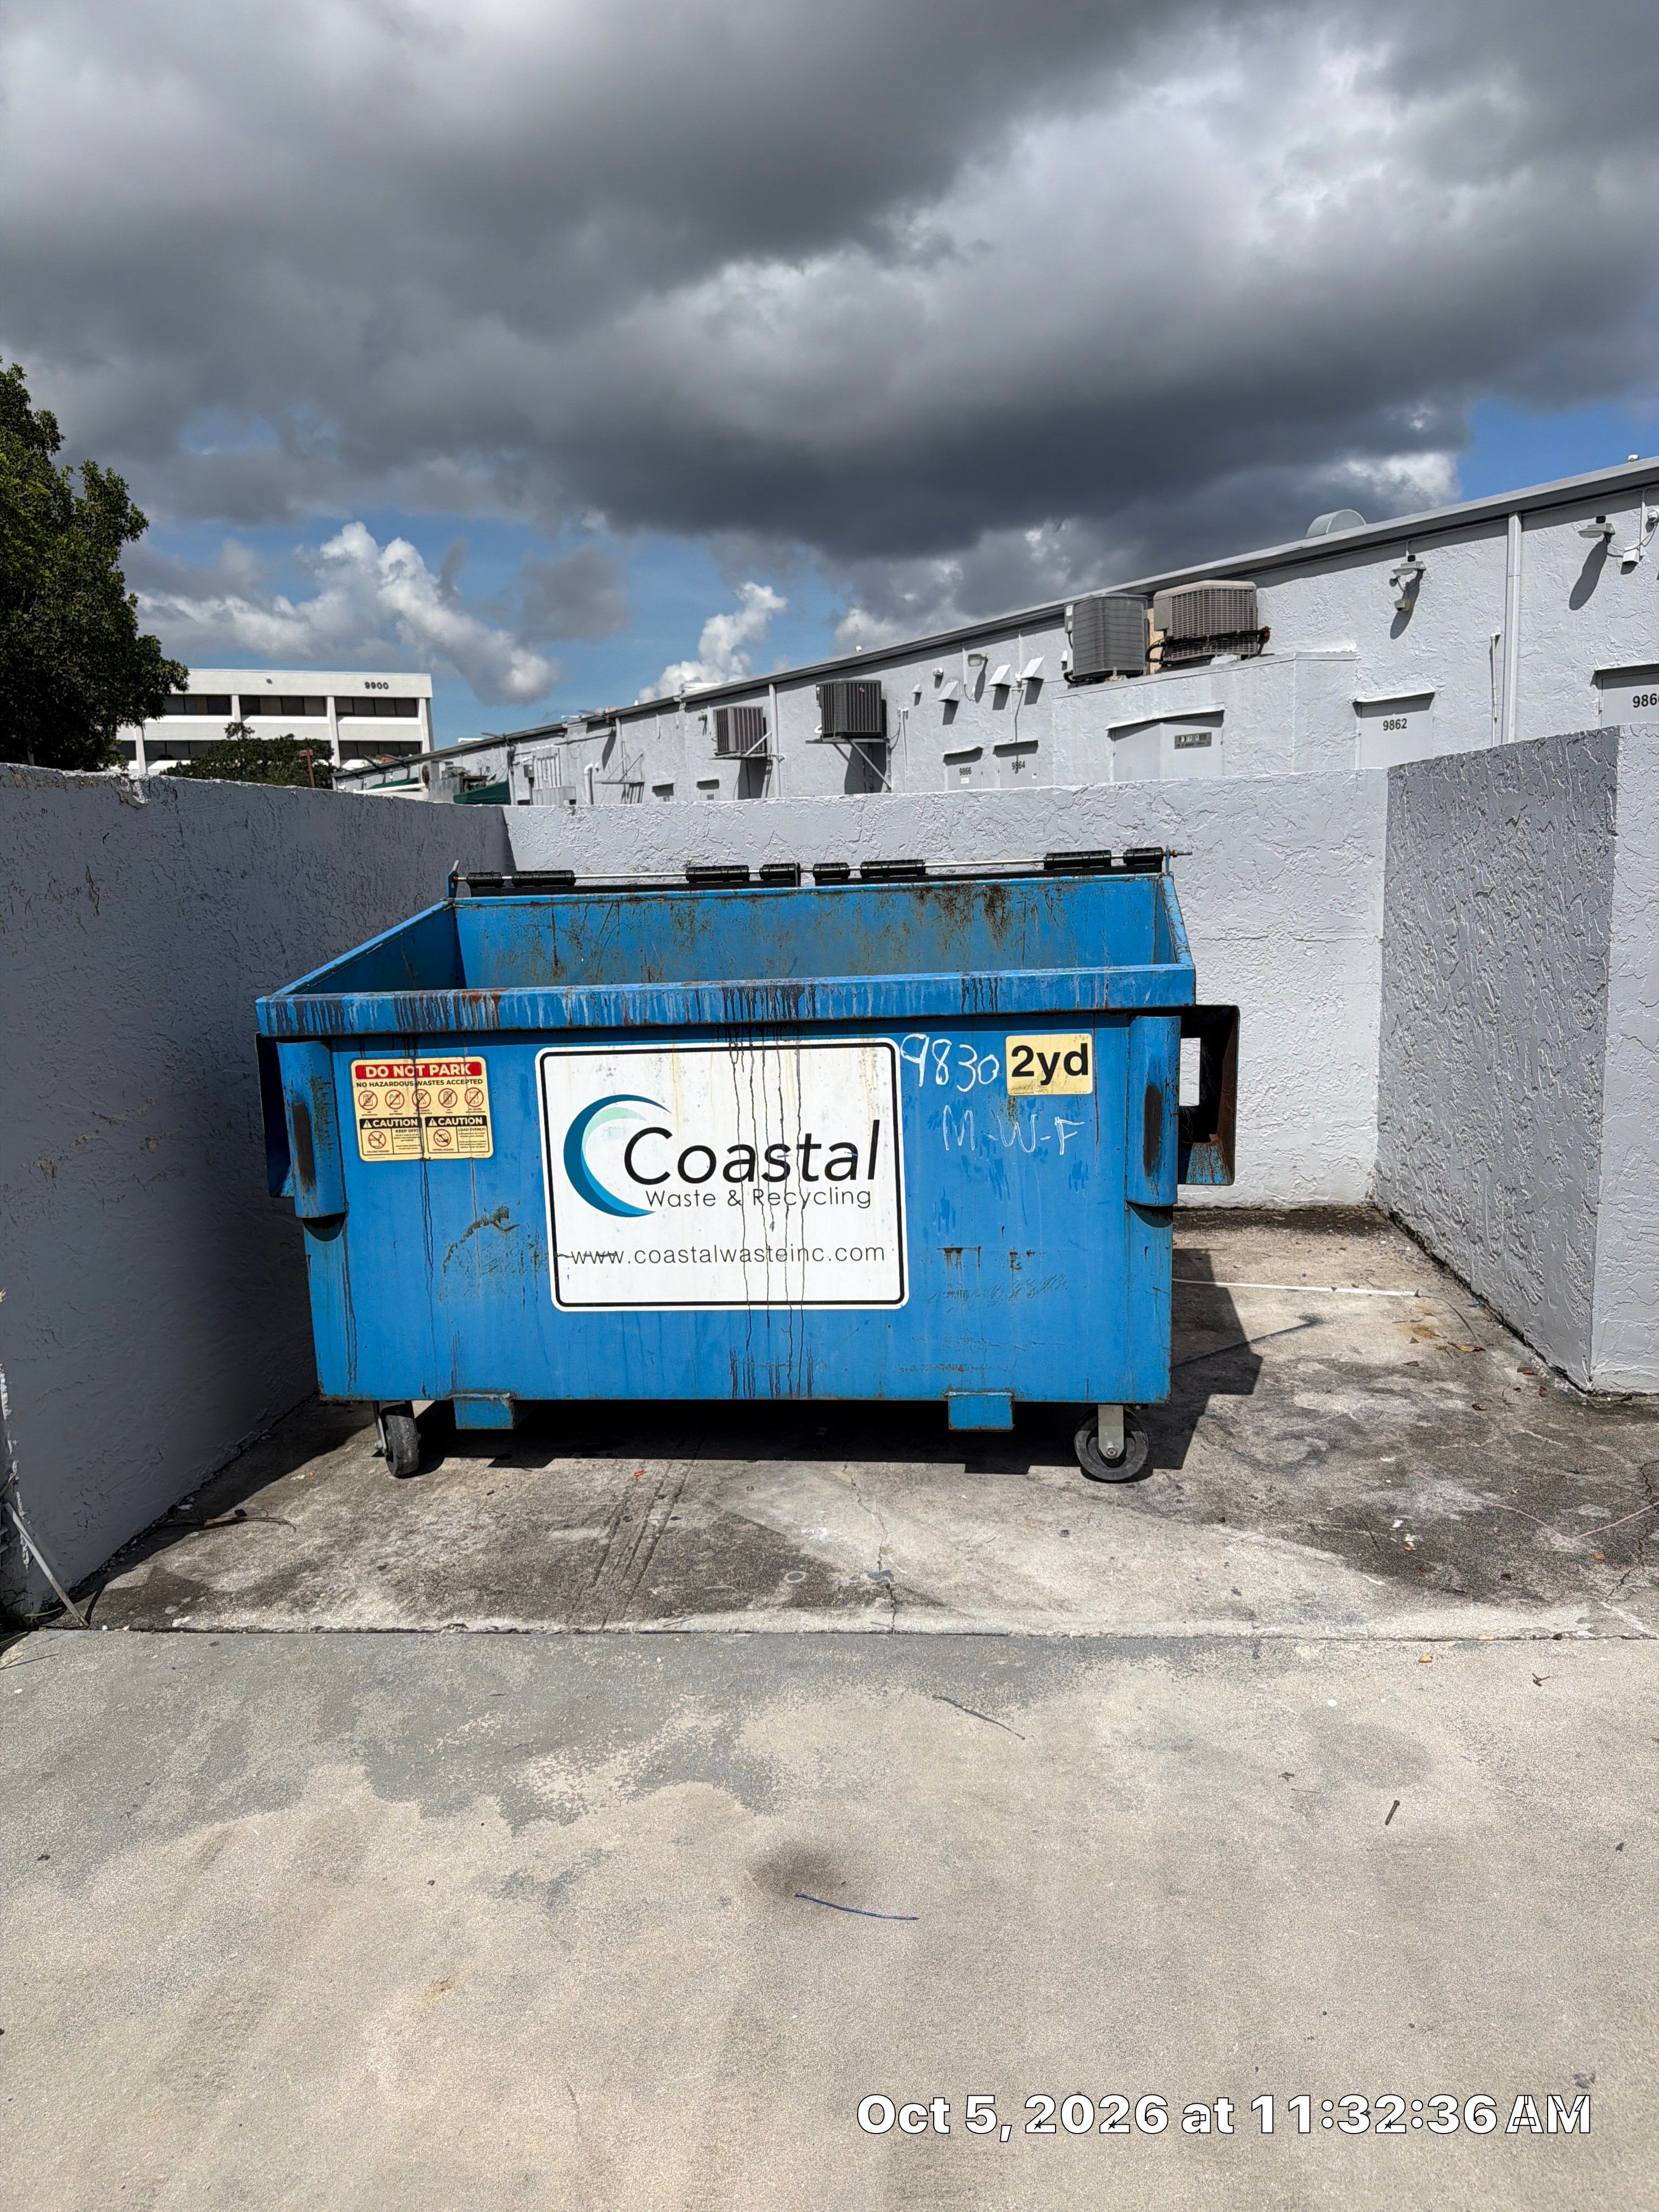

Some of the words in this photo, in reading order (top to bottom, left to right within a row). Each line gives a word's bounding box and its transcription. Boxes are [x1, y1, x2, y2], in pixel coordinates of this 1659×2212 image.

[364, 681, 389, 690] 9900
[1633, 693, 1659, 708] 986
[1383, 718, 1407, 731] 9862
[960, 767, 972, 776] 9866
[900, 1033, 1000, 1092] 9830
[1011, 1042, 1089, 1086] 2yd
[365, 1066, 389, 1077] DO
[394, 1065, 425, 1077] NOT
[430, 1063, 472, 1076] PARK
[373, 1119, 418, 1127] CAUTION
[438, 1116, 483, 1125] CAUTION
[624, 1119, 880, 1185] Coastal
[645, 1189, 716, 1207] Waste
[727, 1189, 743, 1206] &
[753, 1187, 871, 1209] Recycling
[571, 1244, 885, 1265] www.coastalwasteinc.com
